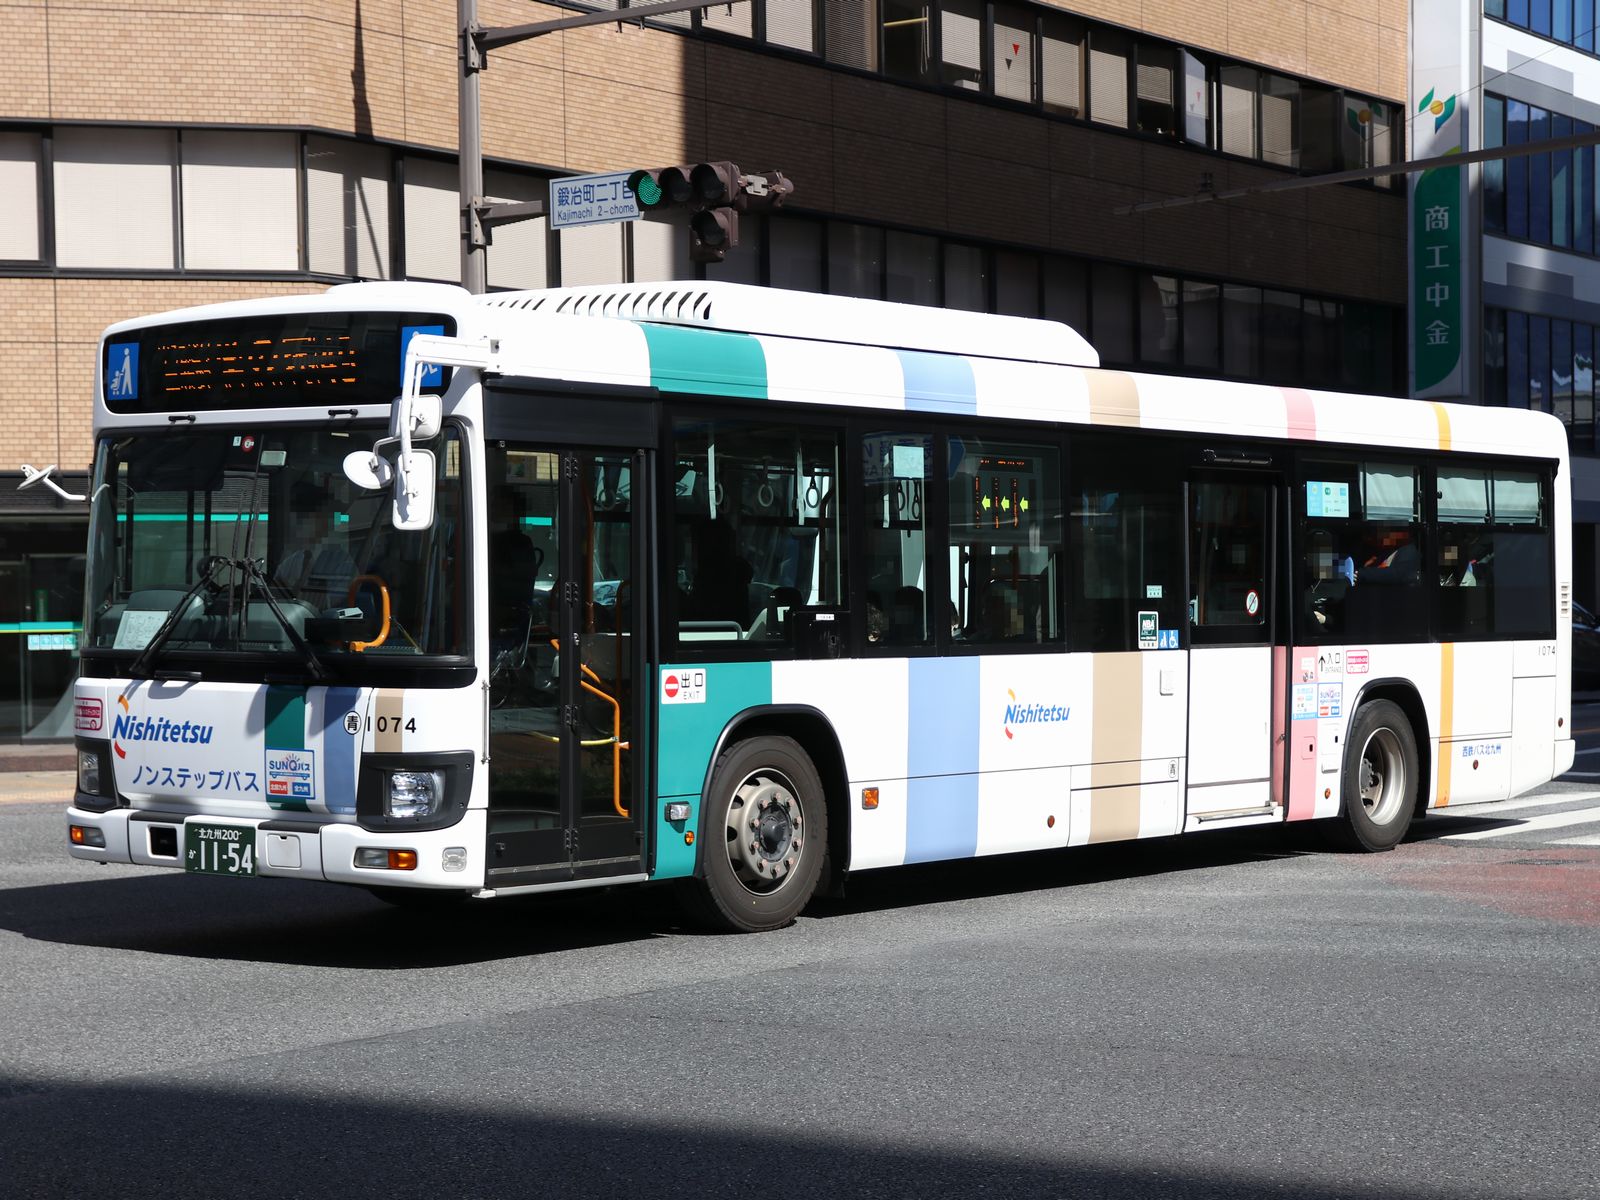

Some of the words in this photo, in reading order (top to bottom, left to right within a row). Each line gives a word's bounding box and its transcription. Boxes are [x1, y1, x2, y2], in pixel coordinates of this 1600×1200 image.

[557, 206, 593, 222] Kajimachi
[1425, 205, 1449, 345] 商工中金
[1326, 652, 1341, 664] 入口
[1538, 646, 1556, 656] 1074
[681, 672, 703, 688] 出口
[683, 691, 700, 700] EXIT
[1004, 703, 1070, 724] Nishitetsu
[112, 715, 213, 744] Nishitetsu
[367, 716, 416, 733] 1074
[132, 765, 259, 792] ノンステップバス
[188, 849, 196, 859] か
[201, 841, 253, 874] 11-54
